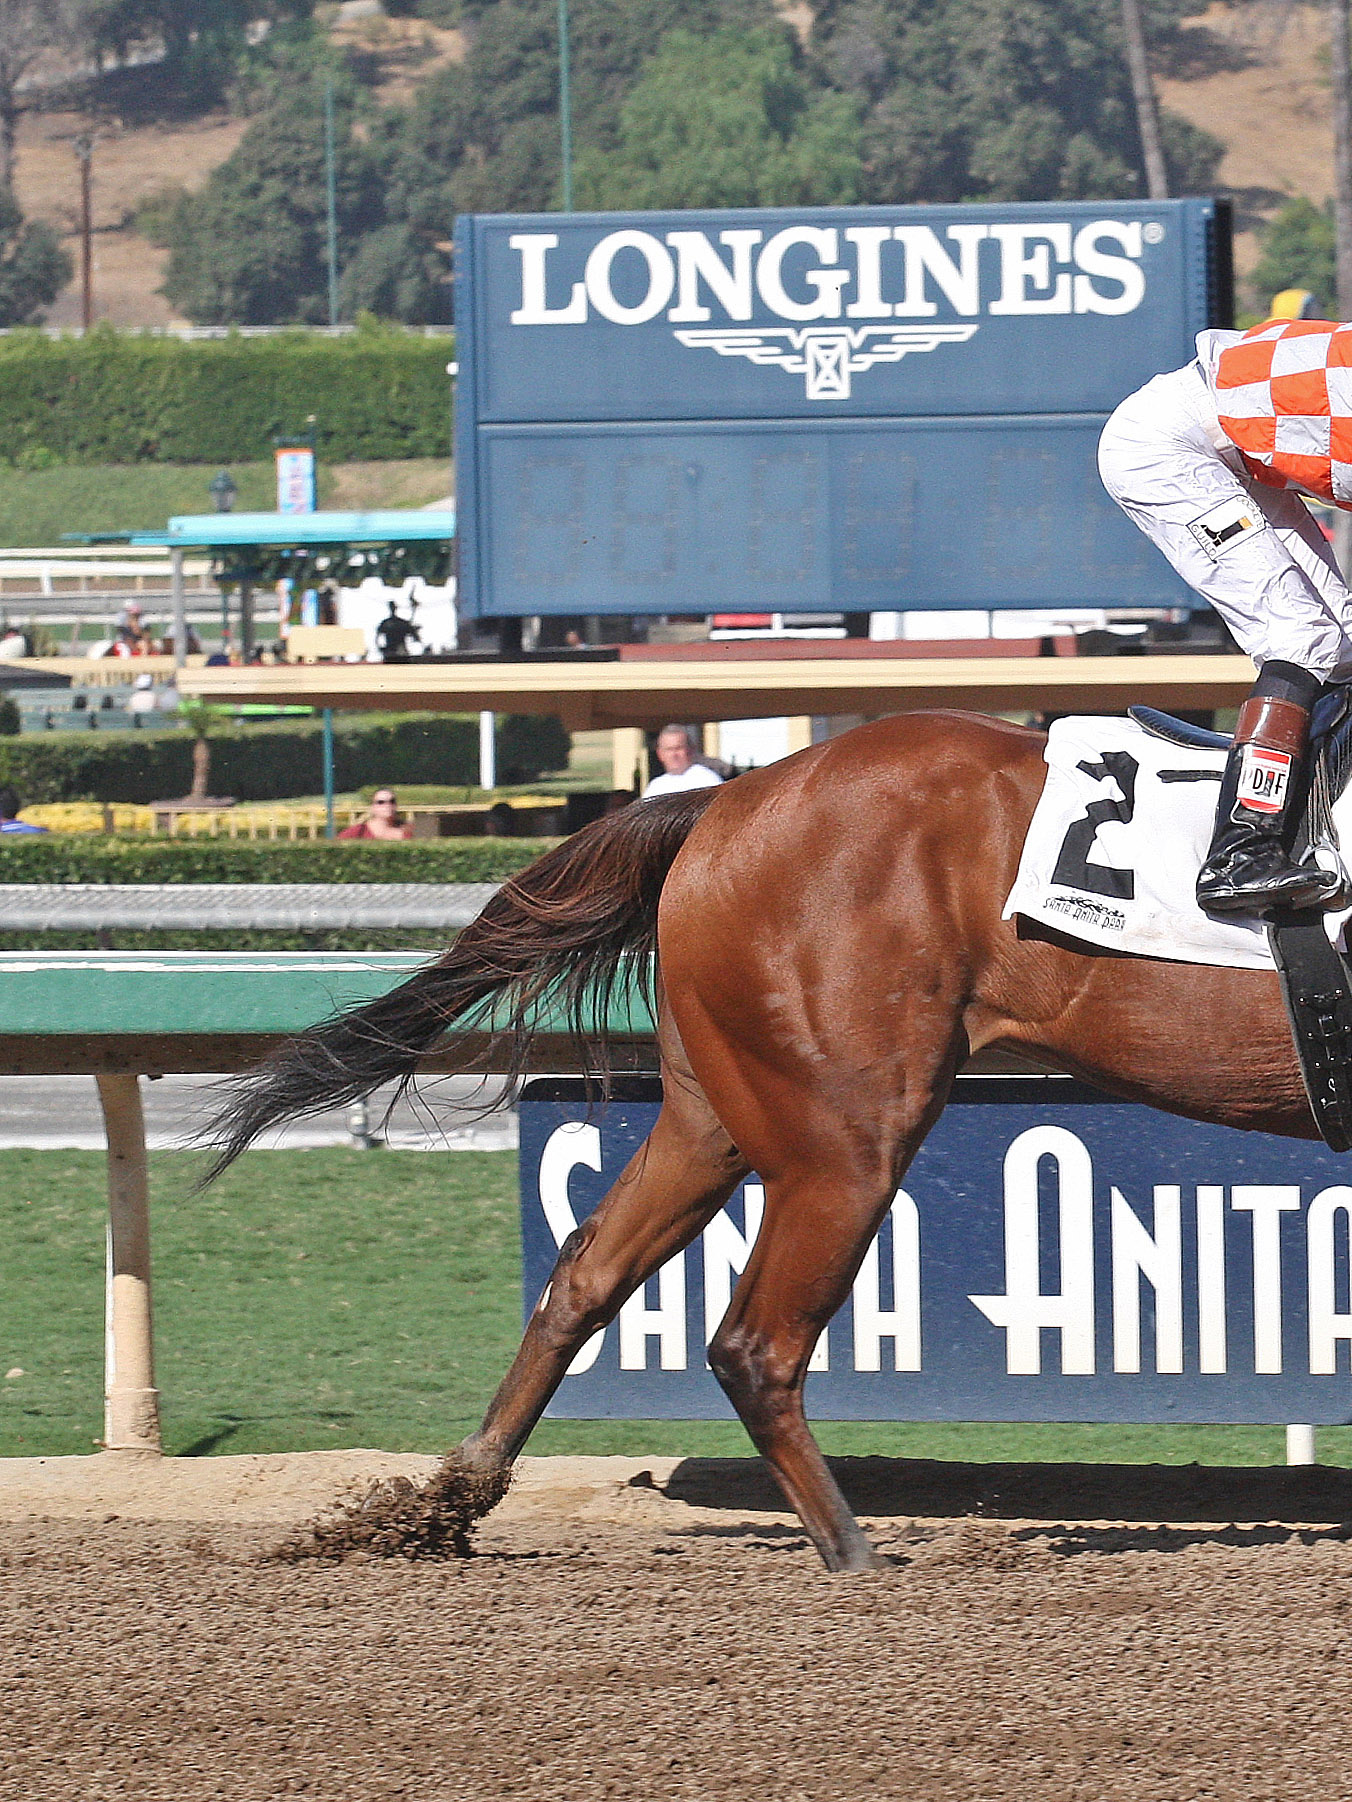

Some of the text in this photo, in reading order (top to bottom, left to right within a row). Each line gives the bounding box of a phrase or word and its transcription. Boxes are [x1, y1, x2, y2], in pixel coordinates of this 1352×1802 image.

[509, 220, 1146, 325] LONGINES
[1190, 524, 1217, 557] GUILD
[1050, 750, 1140, 900] 2
[538, 1120, 922, 1376] SANA
